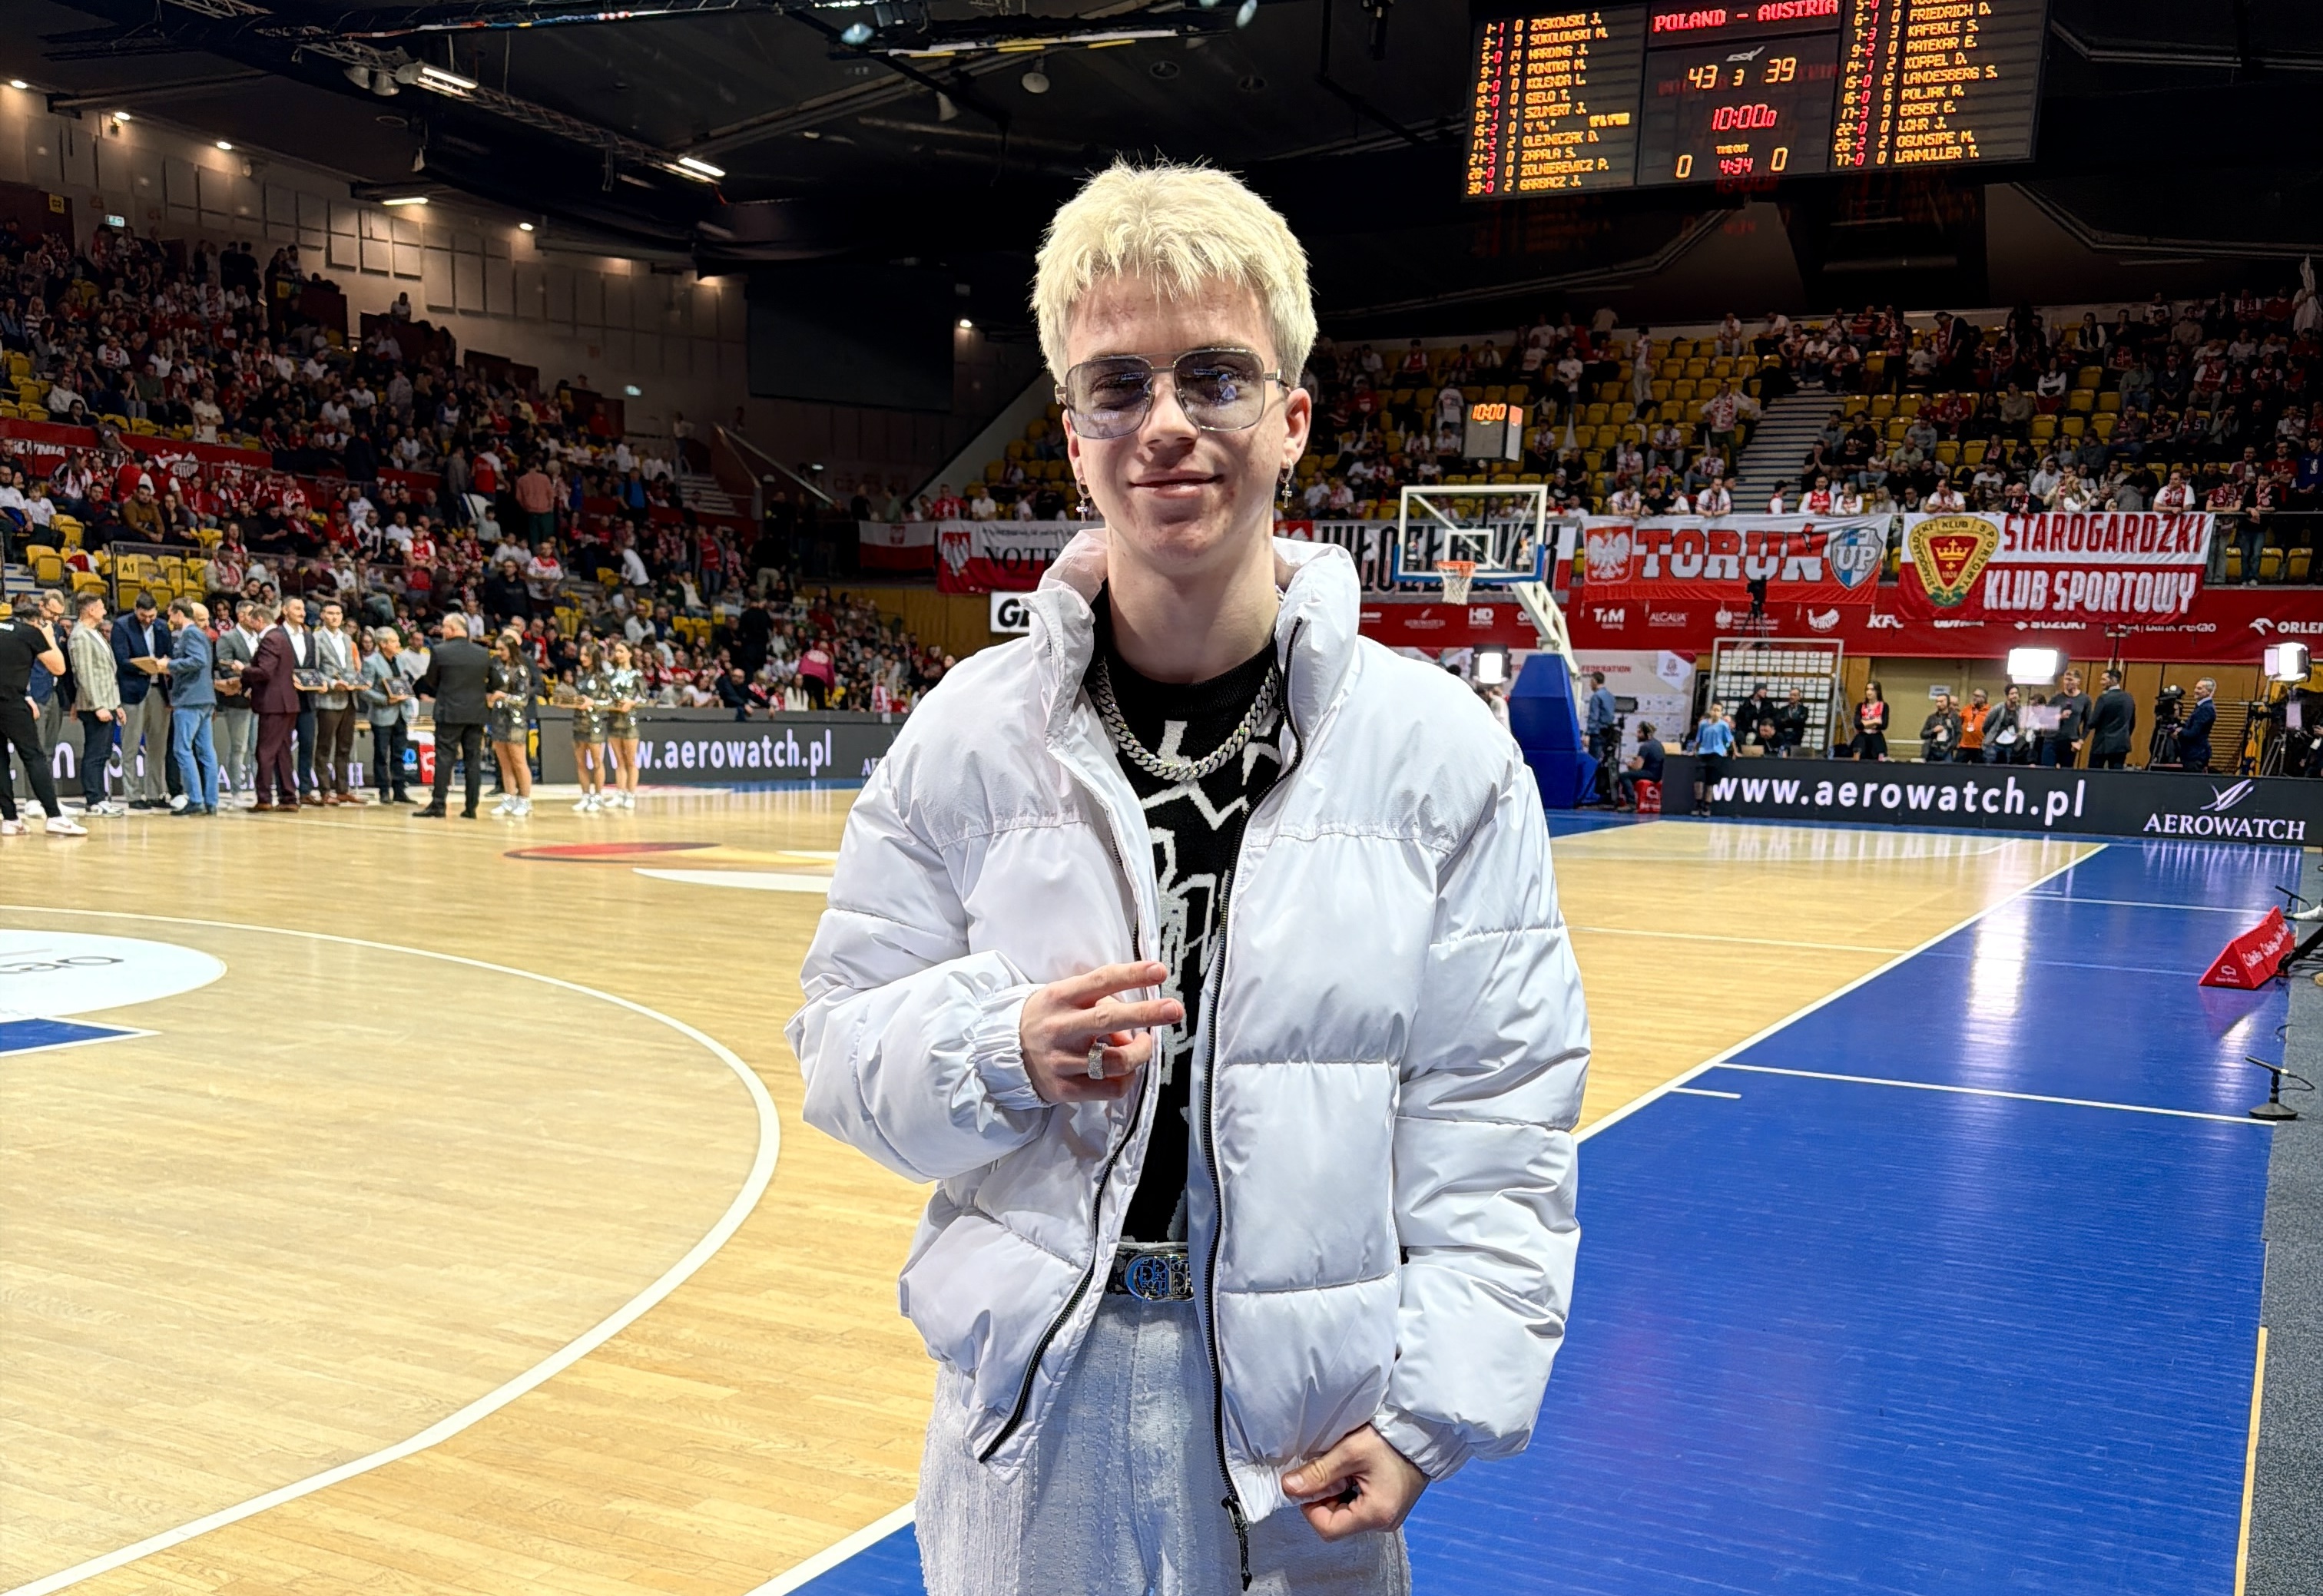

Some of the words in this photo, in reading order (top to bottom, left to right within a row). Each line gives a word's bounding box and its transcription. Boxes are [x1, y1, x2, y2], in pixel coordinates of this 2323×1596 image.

[1515, 20, 1523, 31] 0
[1591, 12, 1602, 25] J.
[1652, 9, 1727, 32] POLAND
[1758, 0, 1838, 22] AUSTRIA
[1854, 12, 1878, 26] 6-1
[1891, 9, 1901, 23] 0
[1909, 3, 1973, 22] FRIEDRICH
[1979, 2, 1992, 15] D.
[1483, 37, 1503, 49] 3-1
[1514, 35, 1523, 47] 9
[1596, 28, 1608, 38] M.
[1855, 28, 1877, 41] 7-3
[1890, 25, 1900, 38] 3
[1907, 21, 1960, 38] KAFERLE
[1967, 19, 1979, 31] S.
[1481, 51, 1503, 65] 5-0
[1510, 49, 1521, 61] 14
[1577, 44, 1589, 55] J.
[1851, 43, 1875, 58] 9-2
[1887, 41, 1897, 55] 0
[1906, 37, 1959, 53] PATEKAR
[1964, 35, 1977, 48] E.
[1481, 65, 1501, 79] 9-1
[1574, 58, 1586, 70] M.
[1765, 57, 1797, 83] 39
[1846, 59, 1874, 74] 14-1
[1886, 57, 1896, 70] 2
[1904, 54, 1949, 70] KOPPEL
[1954, 52, 1967, 65] D.
[1511, 78, 1519, 91] 0
[1576, 74, 1586, 85] L.
[1688, 65, 1718, 89] 43
[1733, 68, 1744, 87] 3
[1844, 75, 1872, 89] 15-0
[1881, 73, 1895, 87] 12
[1903, 67, 1980, 84] LANDESBERG
[1985, 65, 1997, 78] S.
[1509, 92, 1519, 104] 0
[1526, 90, 1556, 104] GIELO
[1560, 89, 1570, 101] T.
[1843, 90, 1871, 104] 16-0
[1883, 88, 1893, 101] 6
[1901, 86, 1947, 101] POLJAK
[1951, 84, 1964, 97] R.
[1509, 108, 1518, 119] 4
[1576, 101, 1586, 114] J.
[1841, 106, 1869, 120] 17-3
[1882, 104, 1891, 118] 9
[1900, 102, 1938, 117] ERSEK
[1943, 101, 1957, 113] E.
[1508, 121, 1516, 134] 0
[1835, 121, 1868, 137] 22-0
[1880, 120, 1890, 134] 0
[1898, 118, 1929, 132] LOHR
[1934, 117, 1947, 130] J.
[1473, 137, 1497, 151] 17-2
[1506, 136, 1516, 149] 2
[1834, 137, 1866, 152] 26-2
[1878, 136, 1888, 149] 2
[1960, 130, 1974, 143] M.
[1506, 151, 1515, 163] 0
[1565, 147, 1576, 158] S.
[1771, 147, 1788, 171] 0
[1836, 152, 1865, 167] 77-0
[1877, 151, 1887, 164] 0
[1968, 144, 1980, 158] T.
[1505, 165, 1514, 177] 0
[1597, 157, 1609, 171] P.
[1675, 154, 1692, 178] 0
[1719, 157, 1754, 175] 4:34
[1503, 179, 1513, 191] 2
[1570, 175, 1582, 187] J.
[1472, 403, 1506, 420] 10:00
[1941, 521, 1968, 529] KLUB
[2004, 513, 2205, 553] STAROGARDZKI
[122, 561, 135, 573] A1
[1836, 545, 1876, 571] UP
[1983, 570, 2046, 611] KLUB
[2053, 571, 2197, 614] SPORTOWY
[2278, 621, 2323, 634] ORLE
[1713, 776, 2086, 826] www.aerowatch.pl
[2142, 813, 2306, 840] AEROWATCH
